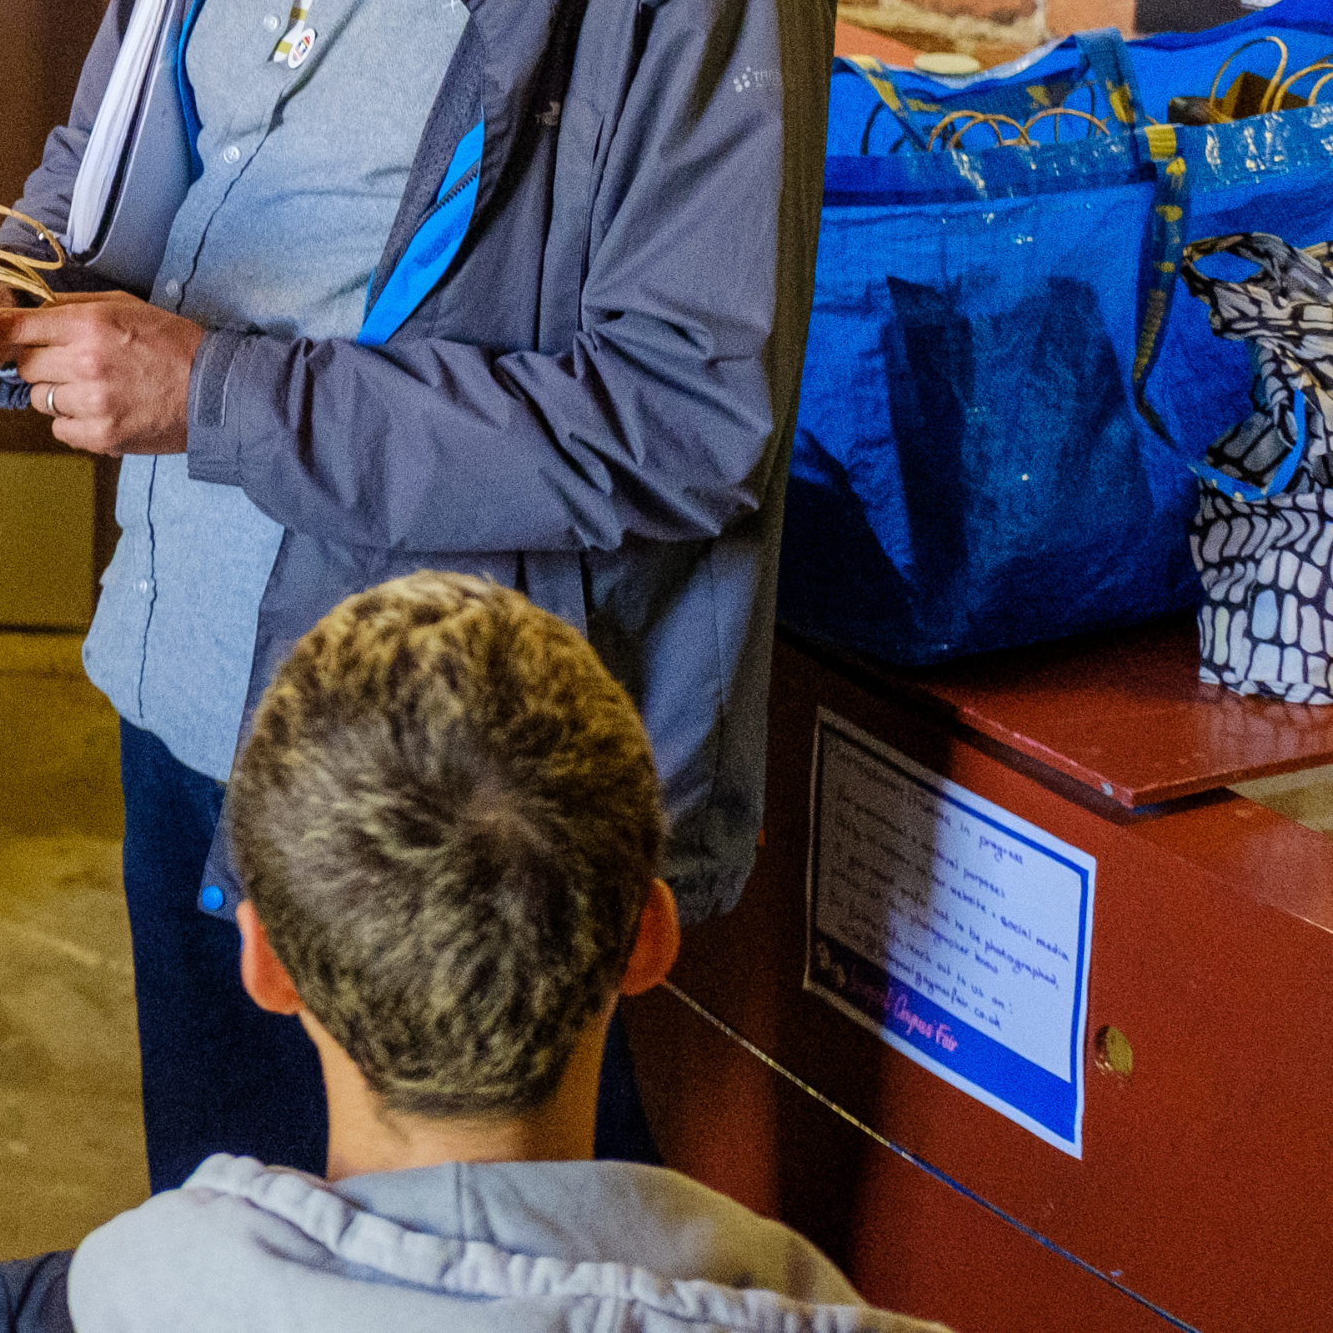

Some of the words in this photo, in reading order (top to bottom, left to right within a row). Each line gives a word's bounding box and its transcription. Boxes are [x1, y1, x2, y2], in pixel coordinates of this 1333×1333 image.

[977, 835, 1023, 865] progress
[963, 867, 1005, 898] purposes
[932, 907, 949, 922] not
[949, 886, 986, 913] website
[999, 915, 1028, 937] social
[1035, 936, 1067, 959] media
[974, 952, 998, 974] know
[936, 961, 951, 975] out
[970, 984, 984, 998] us
[934, 1022, 958, 1052] Fair
